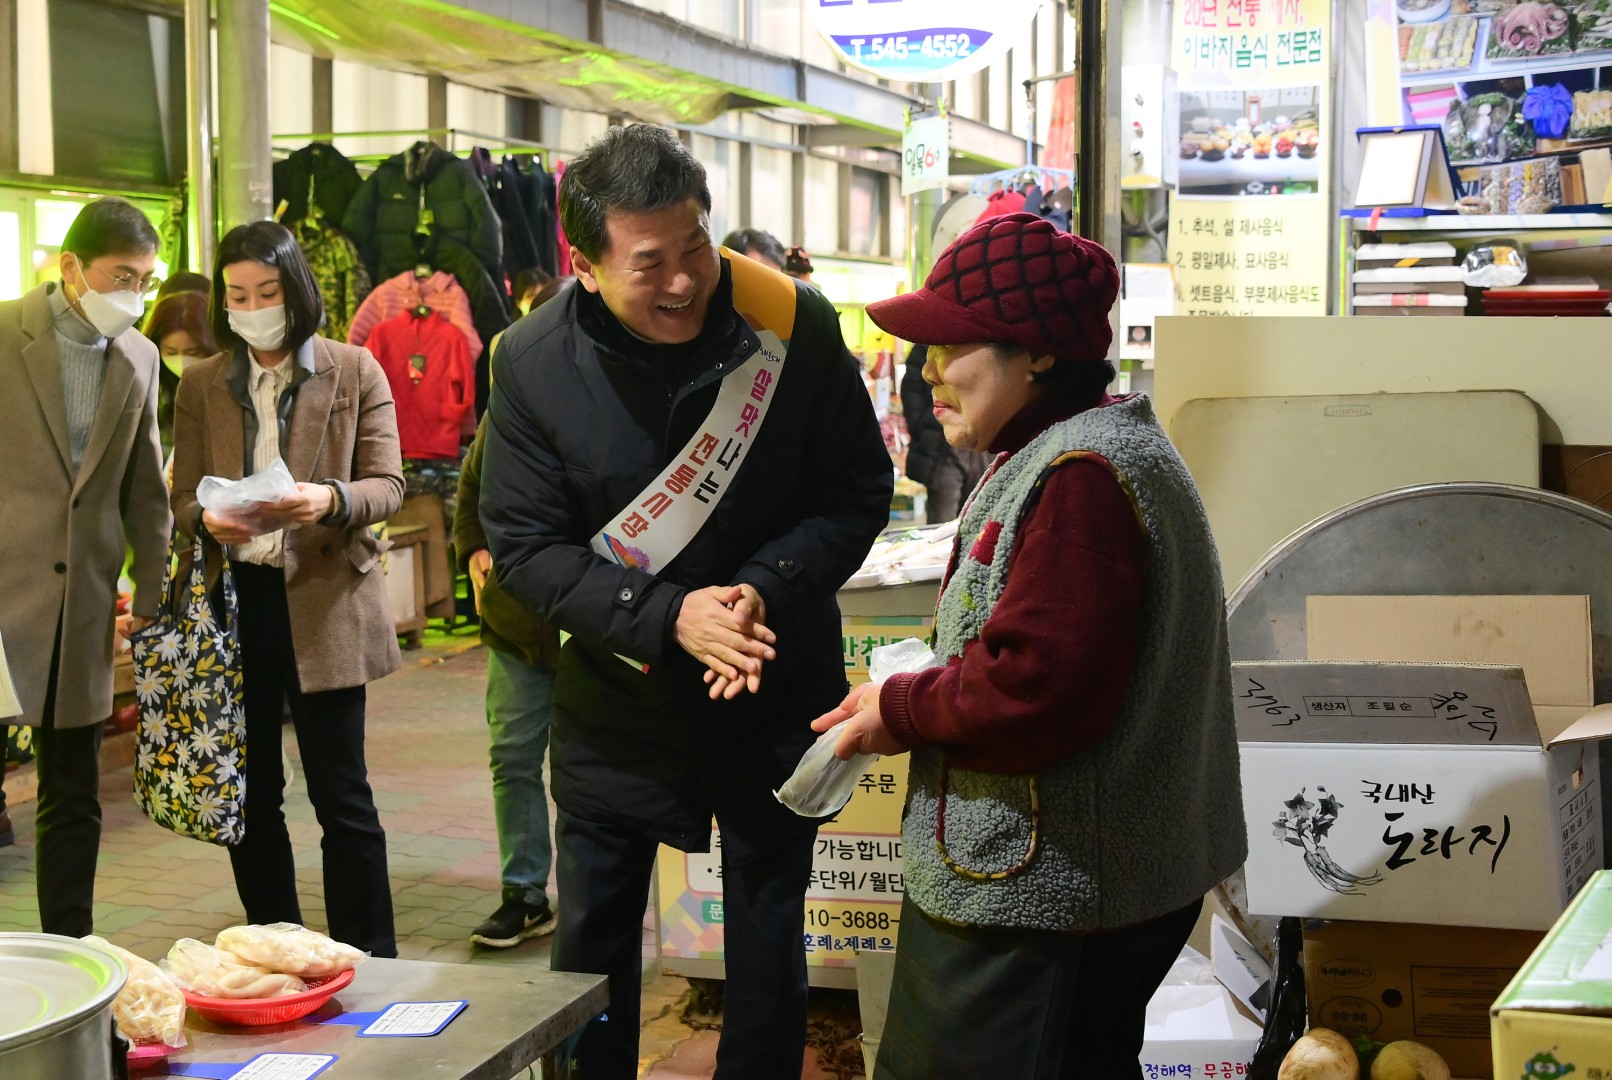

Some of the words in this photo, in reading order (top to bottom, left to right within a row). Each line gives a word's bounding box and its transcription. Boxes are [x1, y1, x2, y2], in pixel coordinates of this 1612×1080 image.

[850, 33, 971, 62] T.545-4552
[1183, 33, 1269, 69] 이바지음식
[1276, 28, 1322, 66] 전문점
[1178, 219, 1188, 236] 1.
[1223, 218, 1235, 237] 설
[1238, 217, 1284, 237] 제사음식
[1175, 251, 1187, 269] 2.
[1245, 251, 1290, 270] 묘사음식
[1243, 284, 1321, 303] 부분제사음식도
[620, 432, 720, 539] 전통시장
[1311, 701, 1347, 711] 생산자
[858, 773, 897, 794] 주문
[1360, 779, 1436, 805] 국내산
[1381, 811, 1511, 874] 도라지
